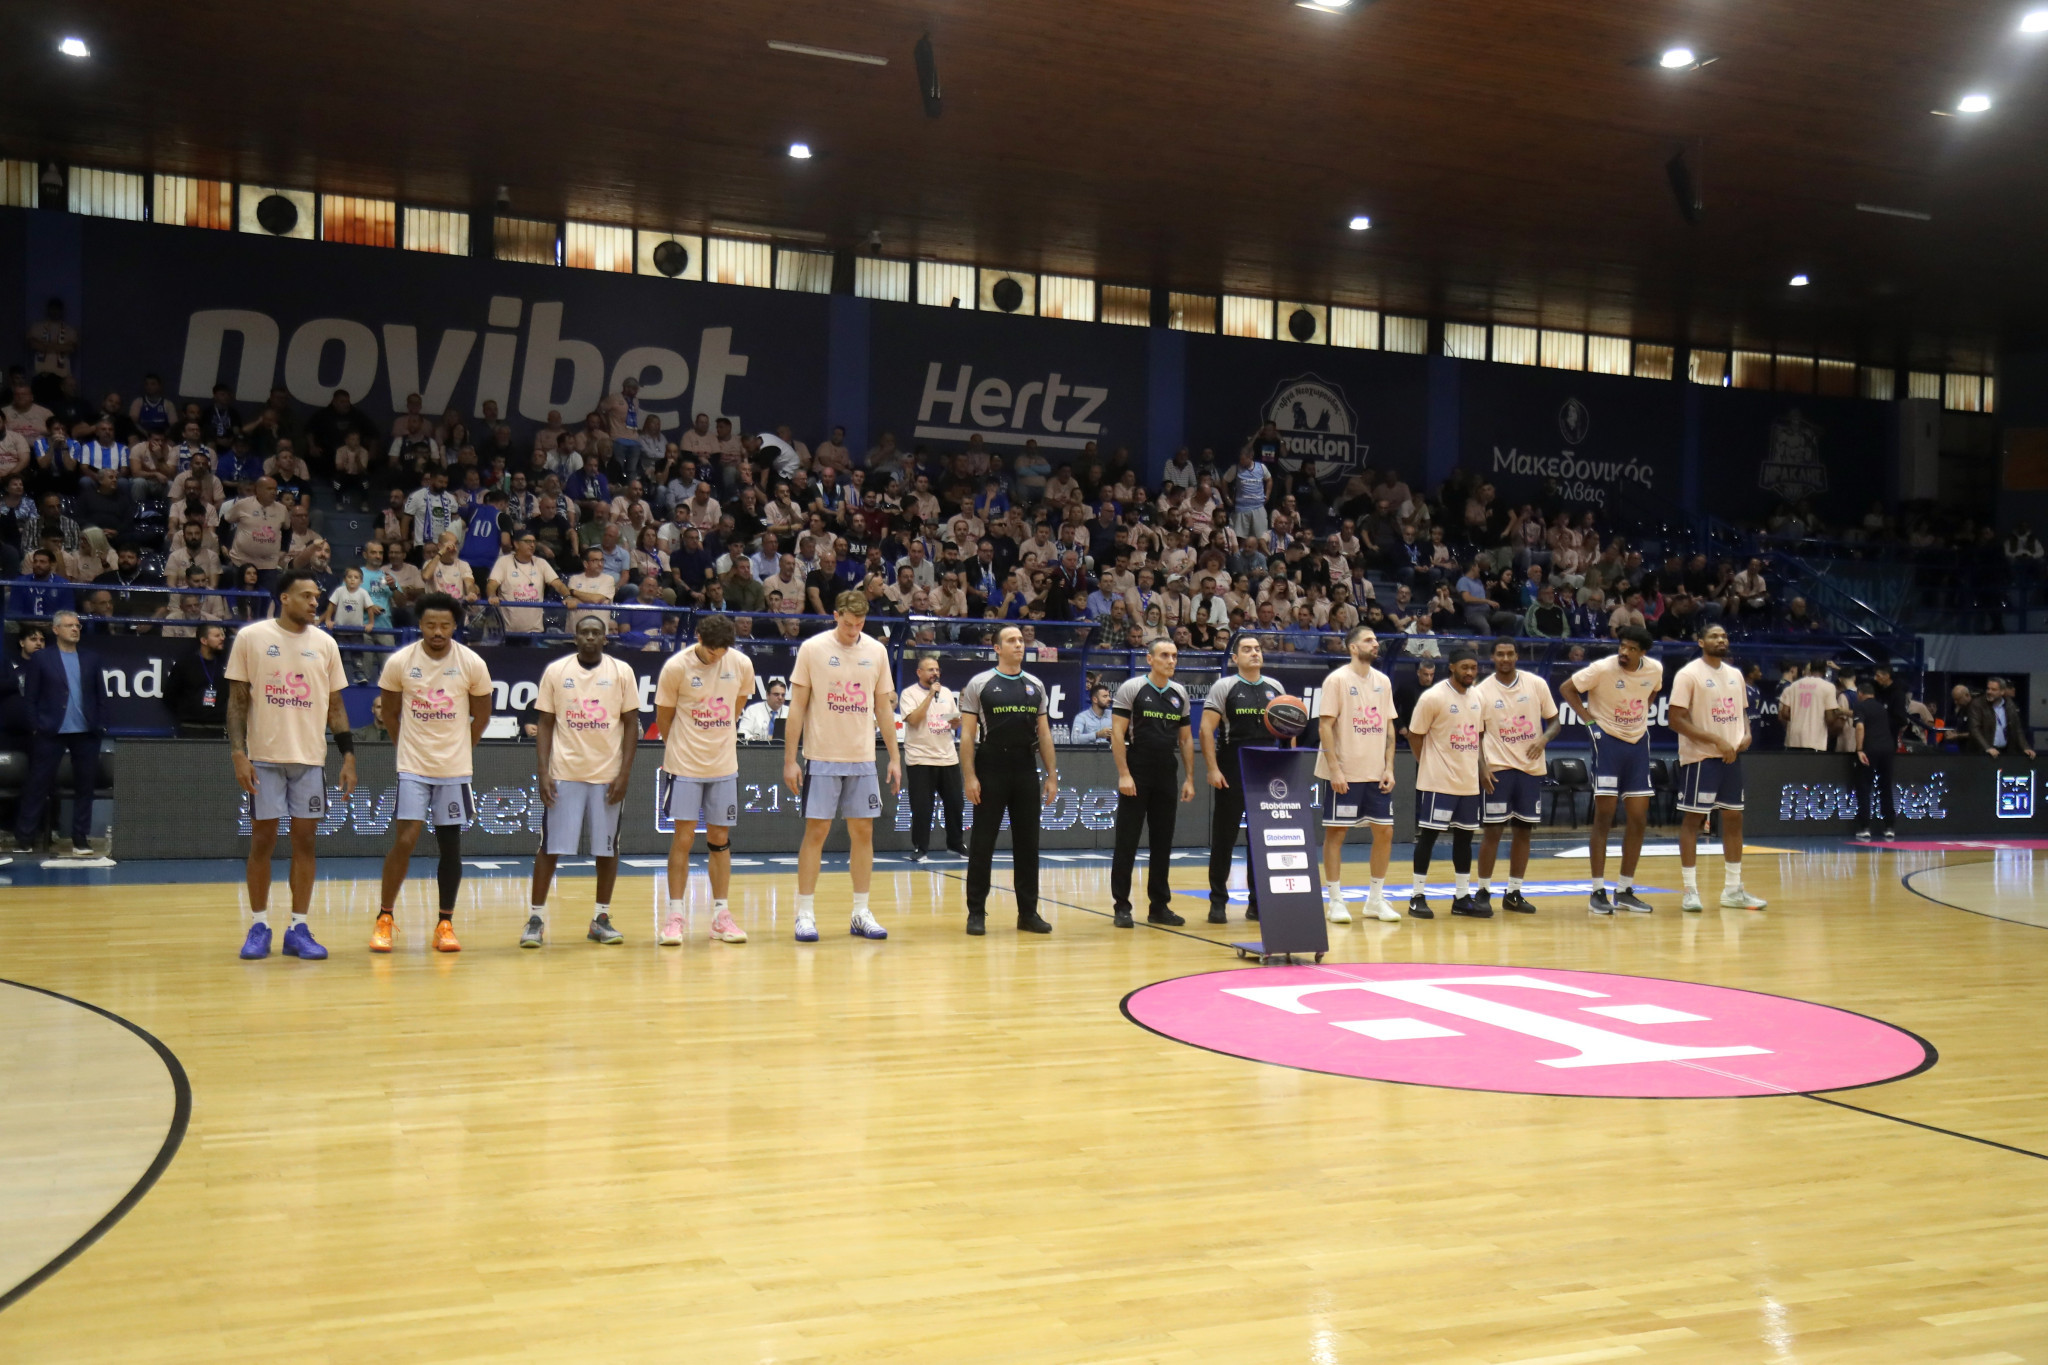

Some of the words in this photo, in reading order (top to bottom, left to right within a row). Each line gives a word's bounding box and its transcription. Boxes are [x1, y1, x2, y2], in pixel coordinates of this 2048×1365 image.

[178, 295, 750, 435] novibet
[917, 361, 1108, 434] Hertz
[1493, 446, 1653, 489] Μακεδονικός
[473, 519, 492, 538] 10
[265, 684, 288, 695] Pink
[265, 694, 313, 708] Together
[827, 692, 848, 702] Pink
[411, 698, 432, 710] Pink
[827, 701, 868, 713] Together
[993, 705, 1038, 714] more.com
[411, 709, 457, 722] Together
[566, 710, 586, 719] Pink
[691, 709, 712, 718] Pink
[1236, 707, 1267, 715] more.c
[1711, 707, 1726, 715] Pink
[566, 719, 610, 731] Together
[694, 718, 731, 730] Togethe
[1352, 717, 1368, 725] Pink
[1499, 727, 1517, 735] Pink
[1501, 733, 1536, 744] Together
[1450, 742, 1478, 752] Togethe
[1271, 810, 1293, 819] GBL
